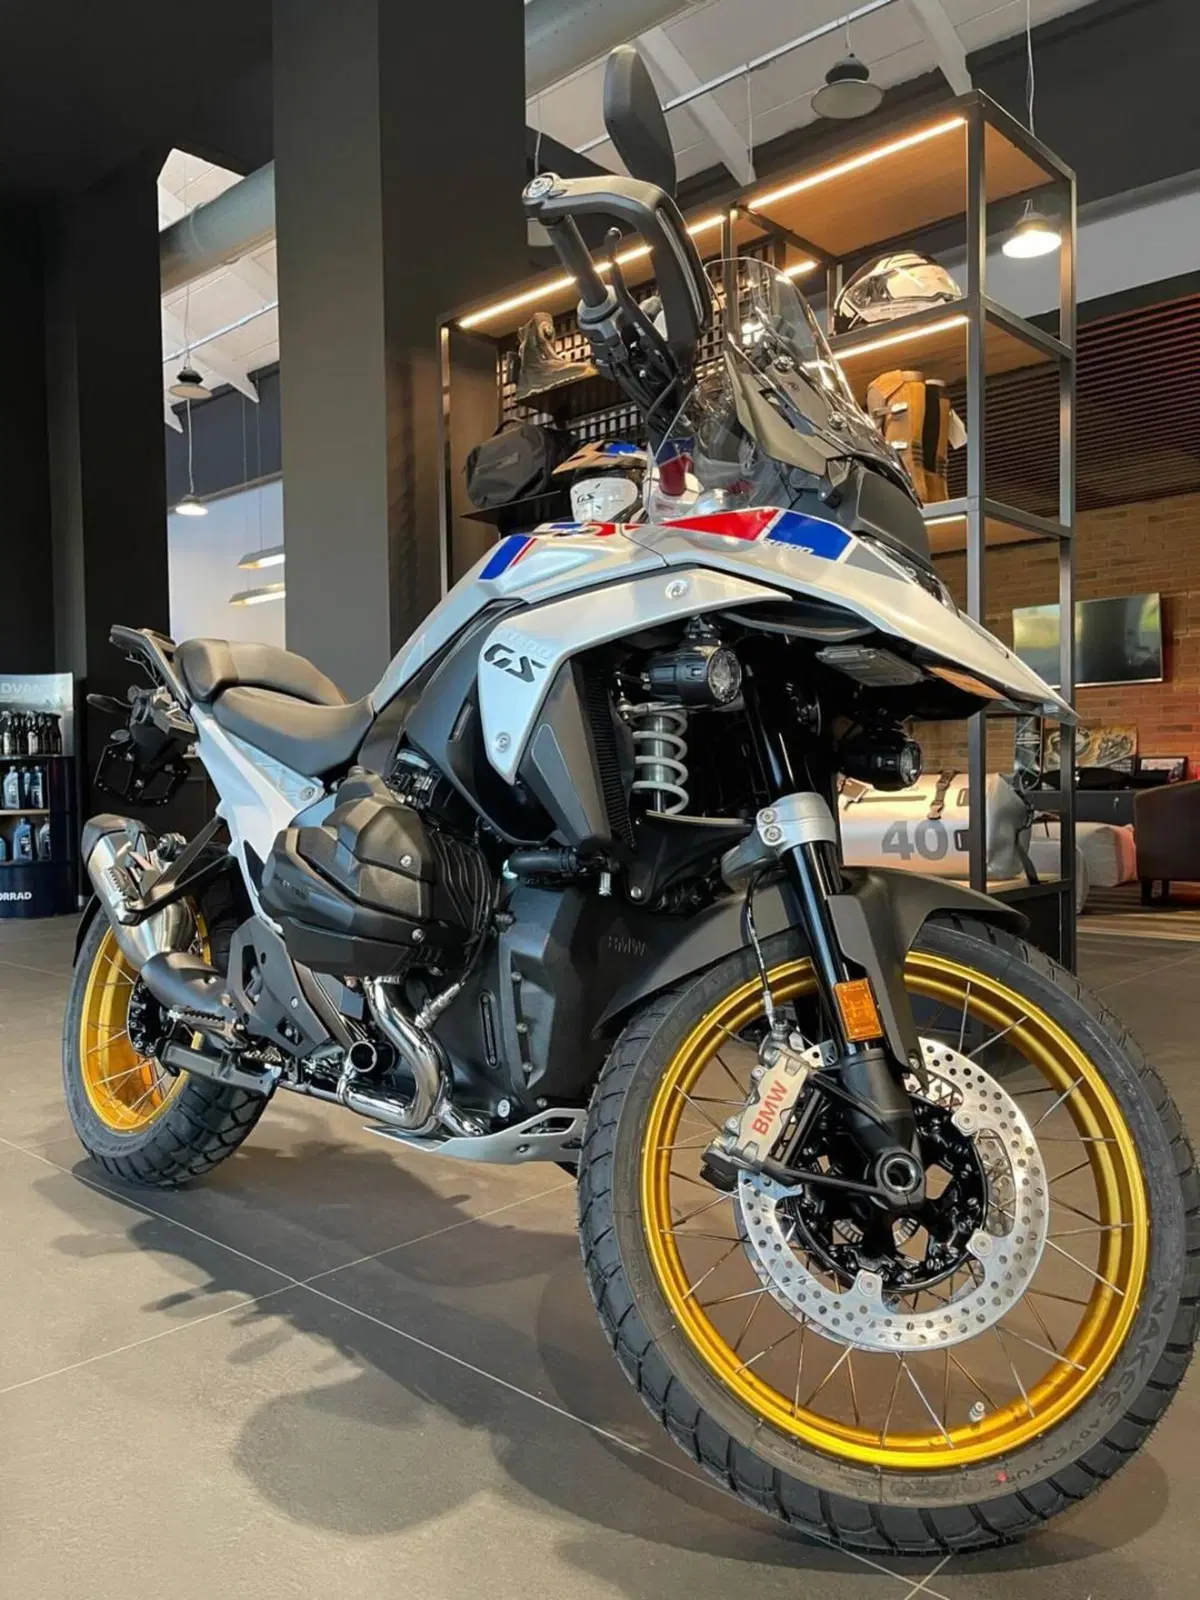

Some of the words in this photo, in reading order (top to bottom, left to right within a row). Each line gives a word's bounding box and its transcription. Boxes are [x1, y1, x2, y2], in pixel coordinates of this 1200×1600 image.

[483, 643, 547, 683] GS
[881, 820, 949, 861] 40
[608, 935, 647, 957] BMW
[751, 1080, 788, 1136] BMW
